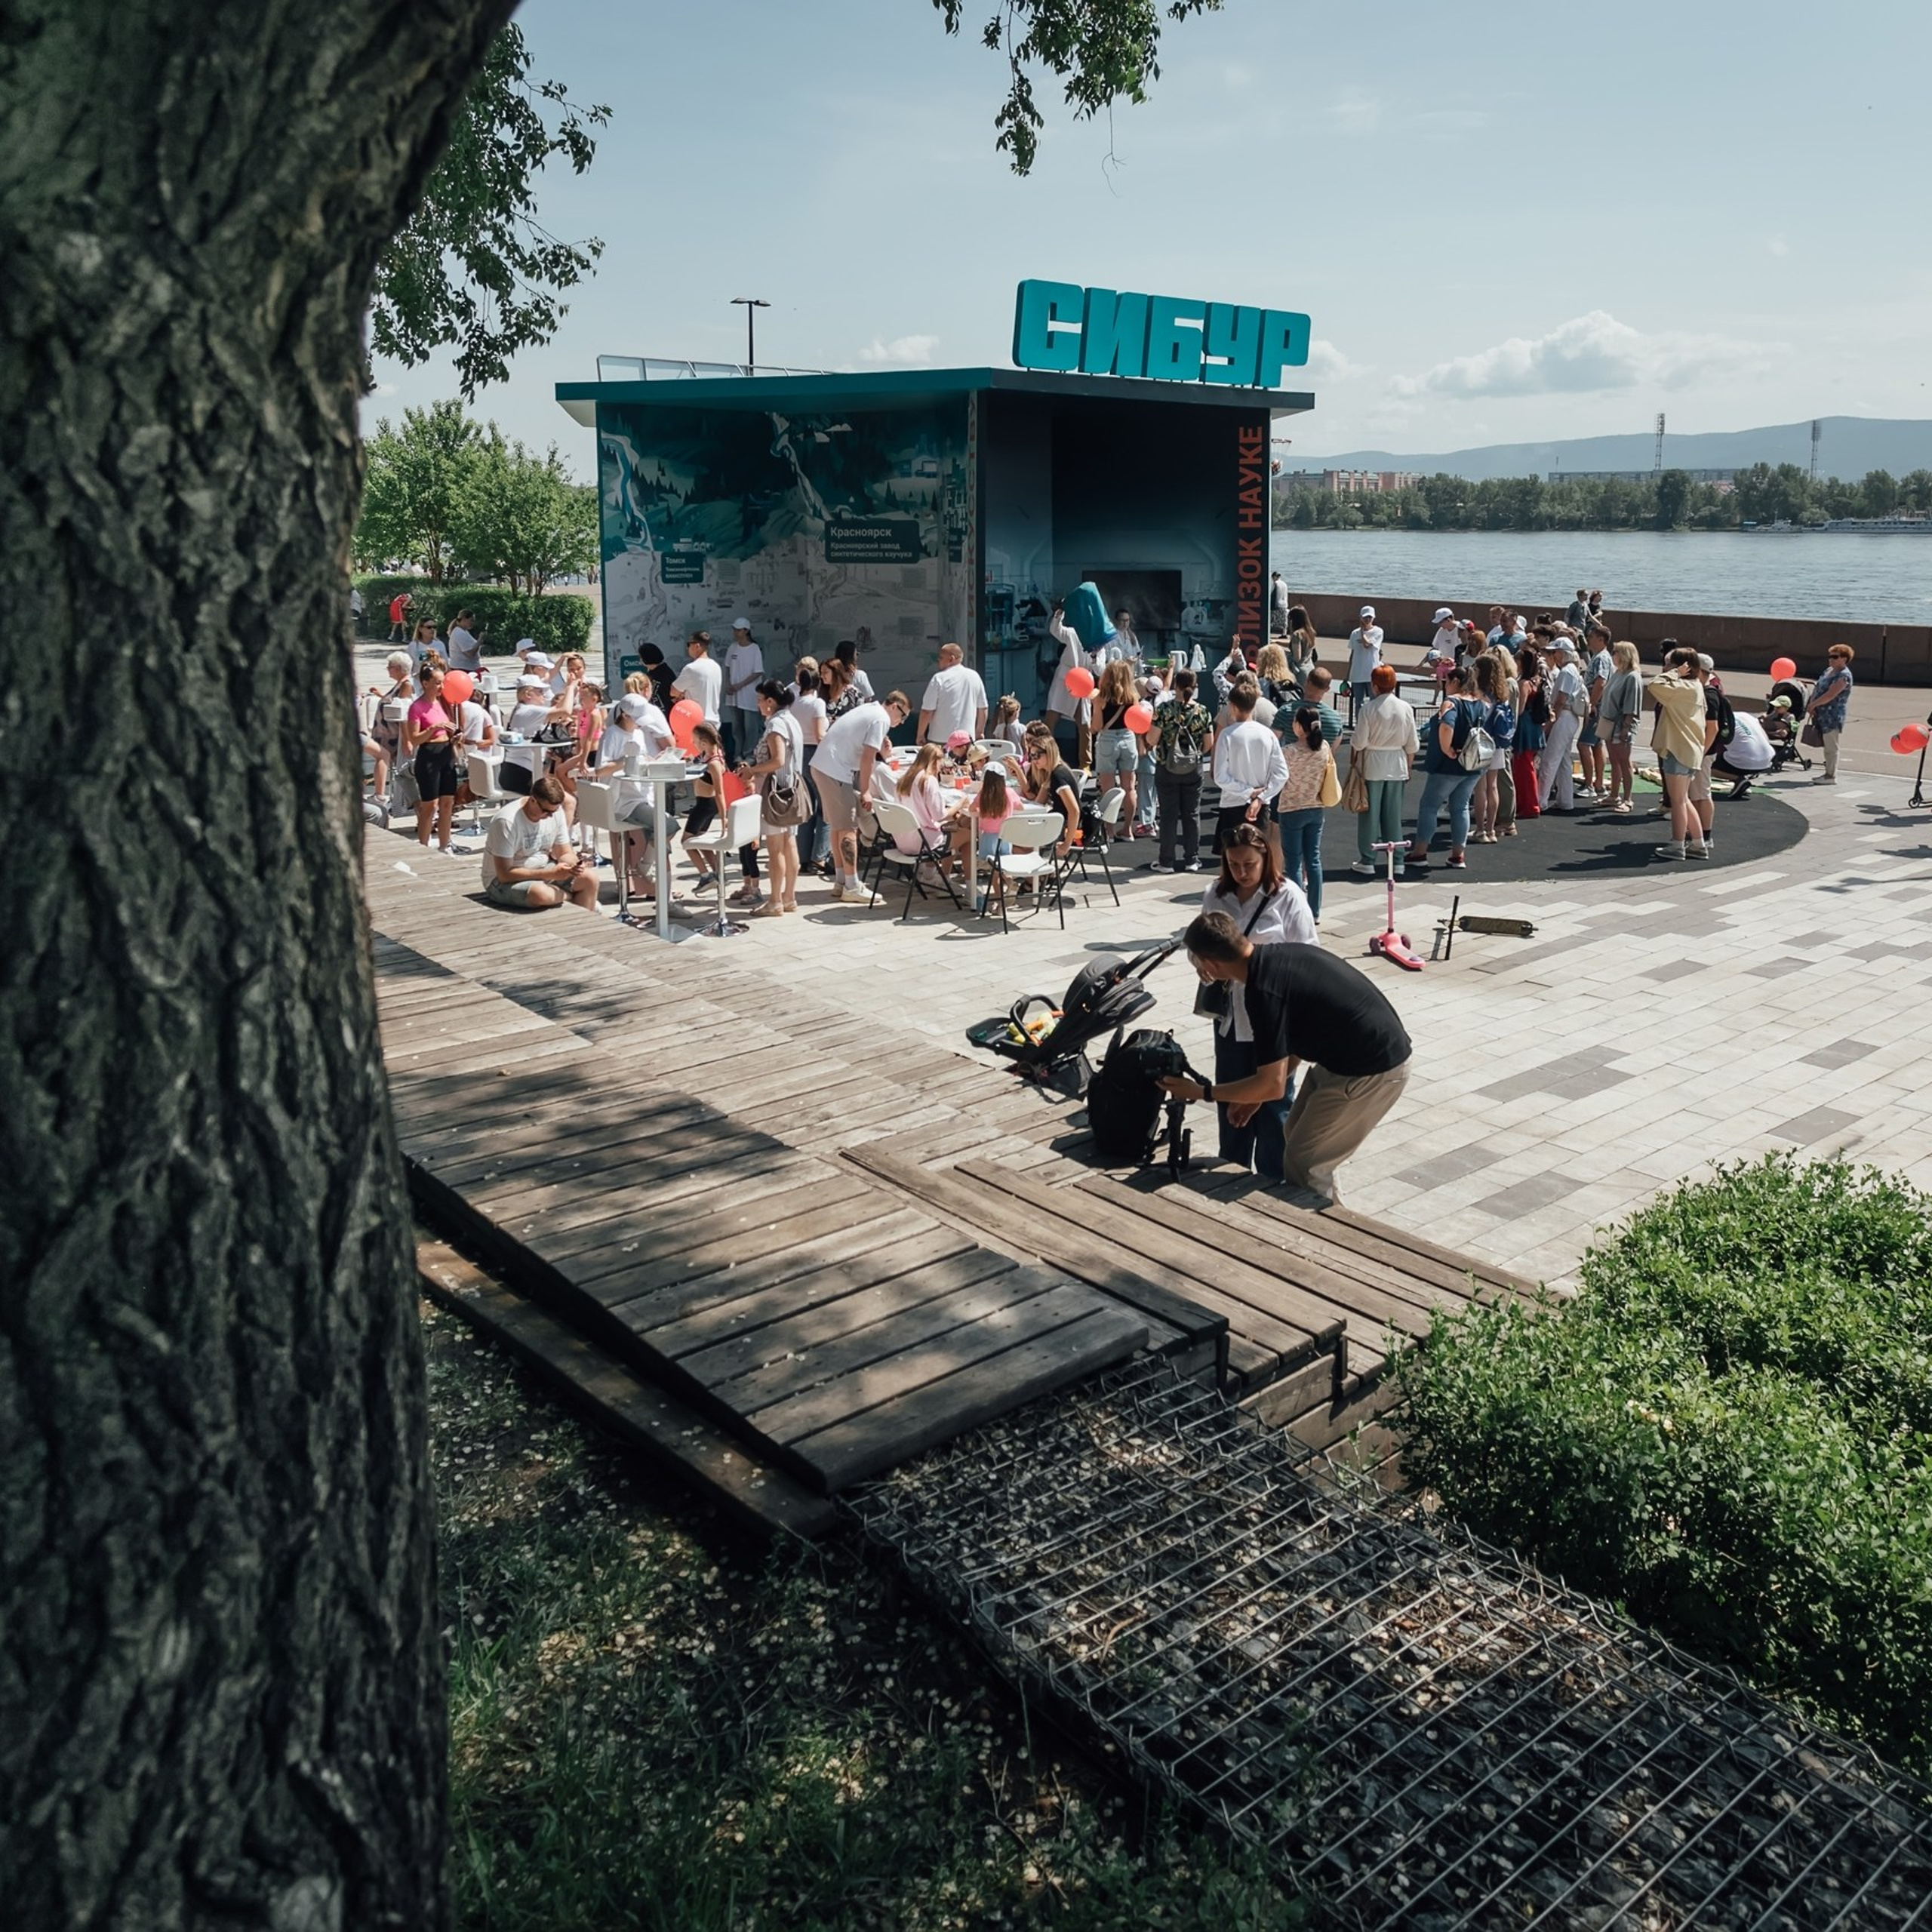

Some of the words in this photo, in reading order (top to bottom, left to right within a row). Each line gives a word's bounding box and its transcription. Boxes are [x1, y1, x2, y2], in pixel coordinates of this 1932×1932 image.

[1013, 279, 1312, 388] СИБУР
[1238, 426, 1263, 528] НАУКЕ
[831, 527, 892, 538] Красноярск
